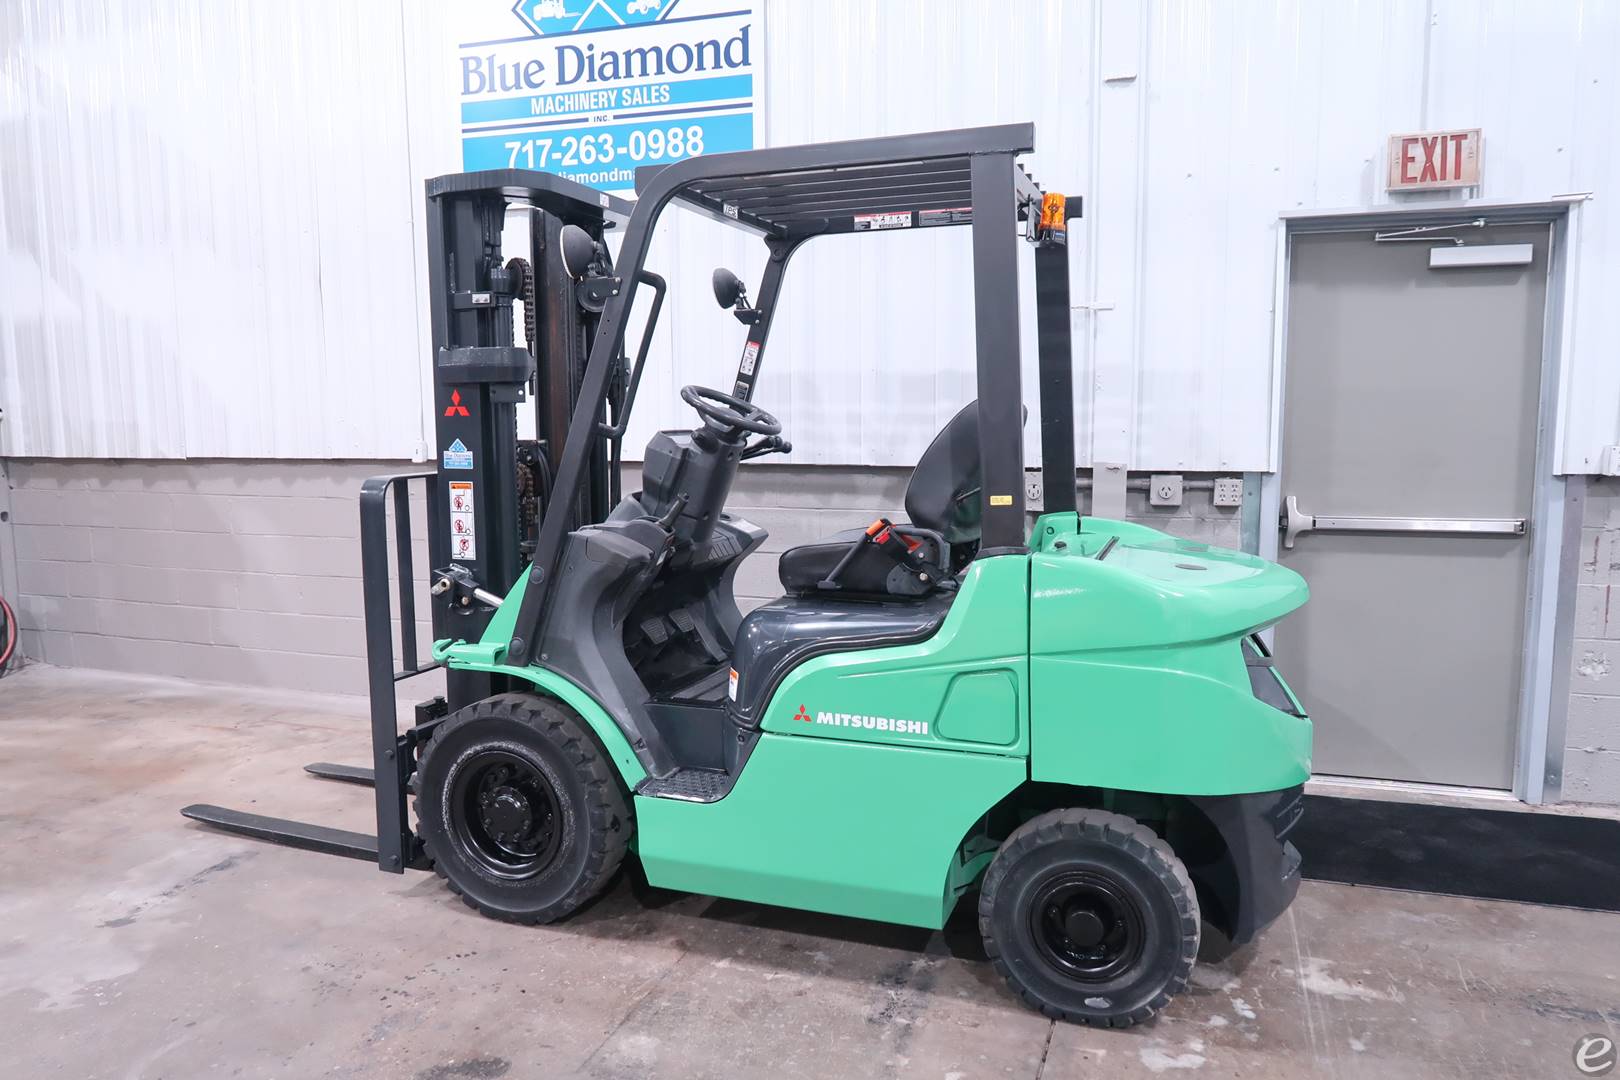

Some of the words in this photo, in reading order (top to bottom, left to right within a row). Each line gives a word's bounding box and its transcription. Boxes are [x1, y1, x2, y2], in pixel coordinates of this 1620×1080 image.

[460, 54, 546, 96] Blue
[554, 24, 752, 87] Diamond
[530, 88, 617, 116] MACHINERY
[622, 84, 671, 108] SALES
[593, 114, 611, 123] INC.
[504, 125, 705, 169] 717-263-0988
[1400, 133, 1469, 184] EXIT
[816, 711, 929, 735] MITSUBISHI
